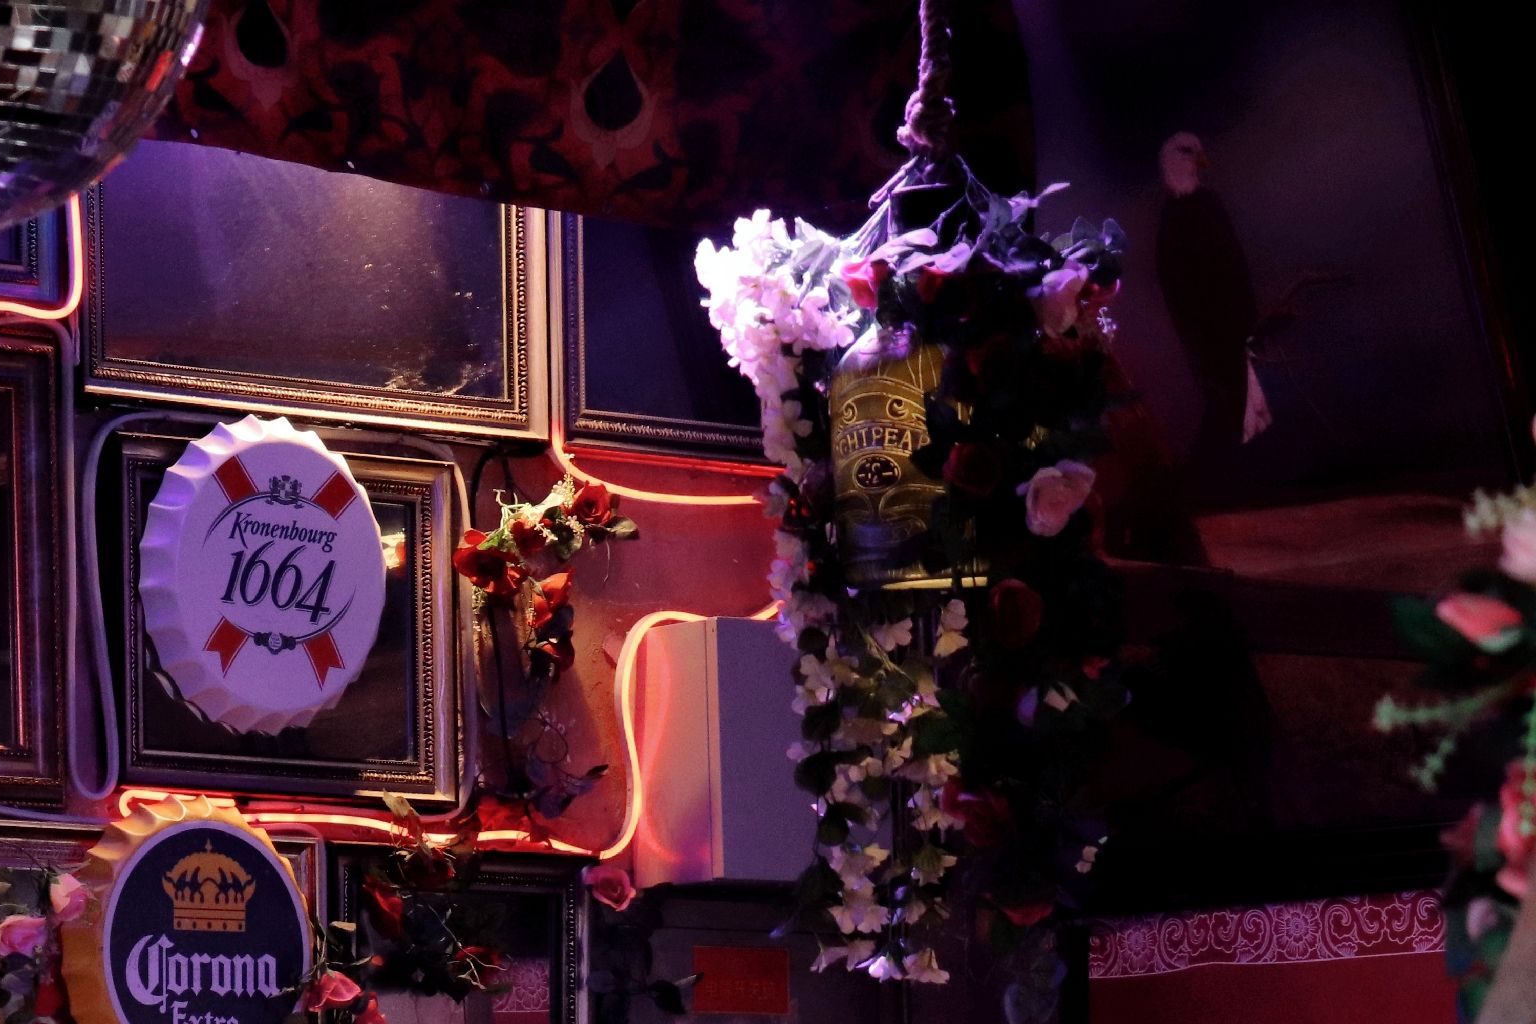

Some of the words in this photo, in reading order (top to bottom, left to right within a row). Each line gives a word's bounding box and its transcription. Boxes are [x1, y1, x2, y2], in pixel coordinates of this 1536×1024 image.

[228, 511, 338, 553] Kronenbourg
[220, 540, 337, 625] 1664
[125, 933, 281, 1014] Corona
